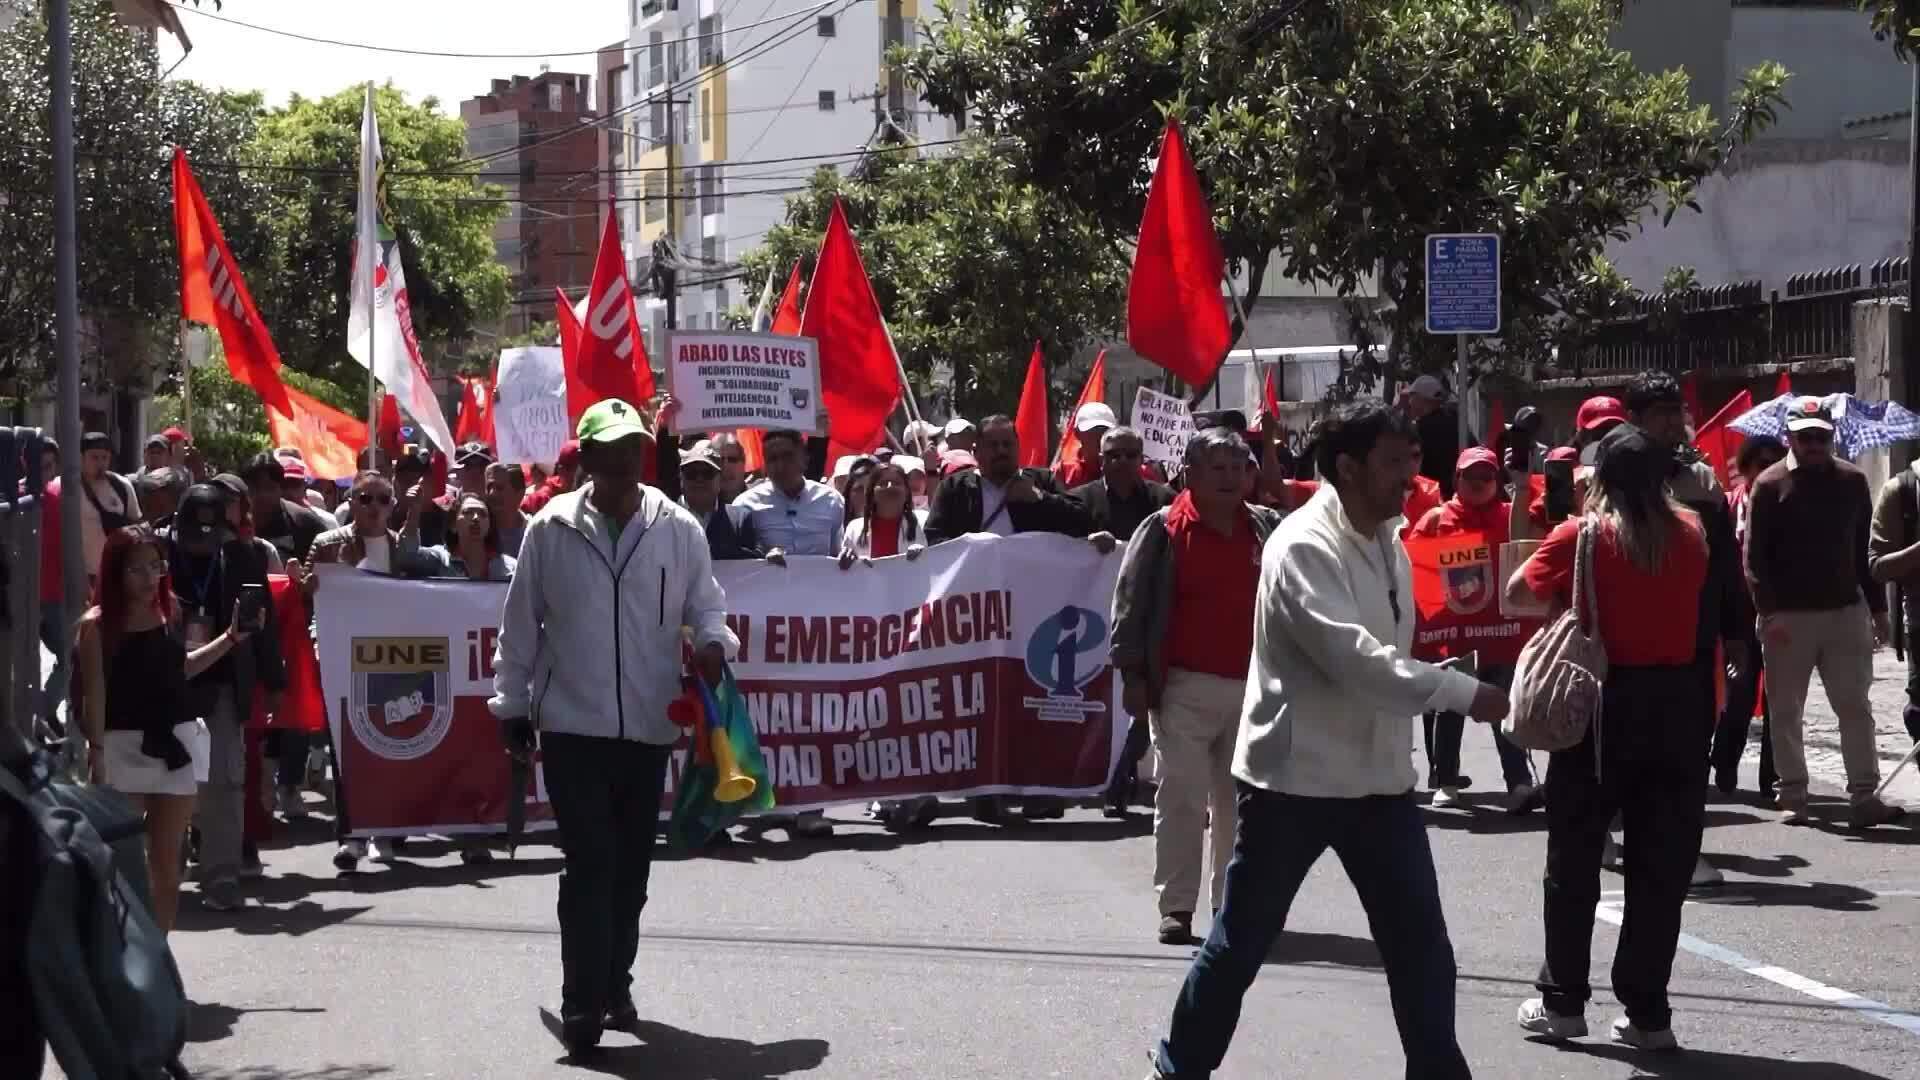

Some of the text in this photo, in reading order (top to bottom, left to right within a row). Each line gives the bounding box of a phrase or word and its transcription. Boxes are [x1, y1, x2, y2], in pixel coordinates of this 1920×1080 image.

[1435, 239, 1448, 259] E
[679, 343, 807, 368] ABAJO LAS LEYES
[1439, 547, 1489, 566] UNE
[765, 590, 1012, 664] EMERGENCIA!
[355, 644, 446, 665] UNE
[738, 671, 986, 737] NALIDAD DE LA
[833, 726, 978, 785] PÚBLICA!
